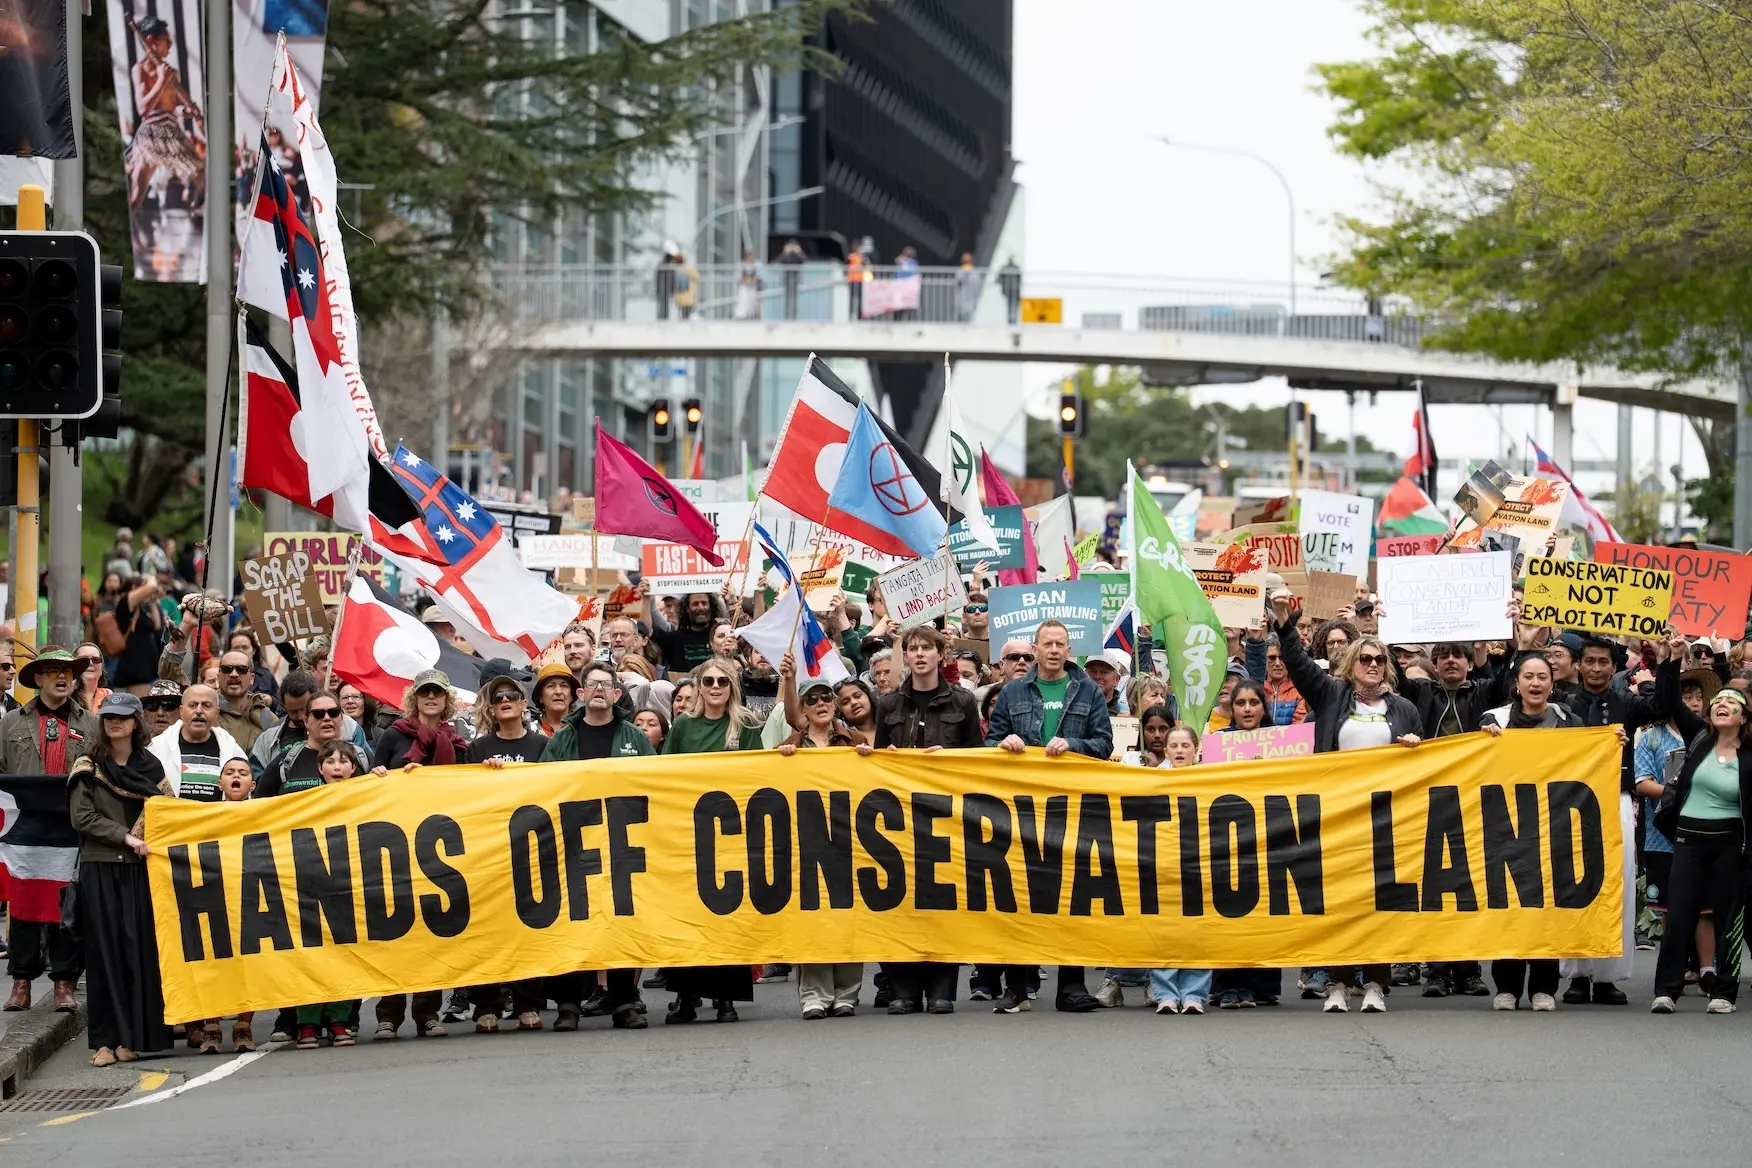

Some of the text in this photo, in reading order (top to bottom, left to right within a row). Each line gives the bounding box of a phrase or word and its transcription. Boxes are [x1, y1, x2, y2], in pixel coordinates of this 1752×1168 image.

[1502, 503, 1531, 512] OTECT
[960, 514, 996, 530] BN
[1317, 512, 1352, 527] VOTE
[1492, 512, 1549, 527] RVATION LAND
[814, 523, 848, 540] WHA
[957, 552, 968, 560] THE
[1387, 542, 1420, 557] STOP
[244, 551, 310, 591] SCRAP
[1195, 571, 1231, 581] ROTECT
[1529, 558, 1671, 591] CONSERVATION
[880, 568, 924, 595] TANGATA
[1101, 583, 1128, 594] AVE
[1232, 587, 1257, 595] LAND
[261, 583, 305, 610] THE
[1022, 590, 1067, 607] BAN
[1568, 584, 1618, 606] NOT
[897, 598, 924, 619] LAND
[992, 608, 1039, 629] BOTTOM
[1041, 606, 1098, 621] TRAWLING
[1669, 602, 1726, 628] ATY
[263, 607, 324, 643] BILL
[1523, 604, 1667, 636] EXPLOITATION
[1221, 727, 1290, 746] PROTECT
[167, 781, 1606, 962] HANDS OFF CONSERVATION LAND
